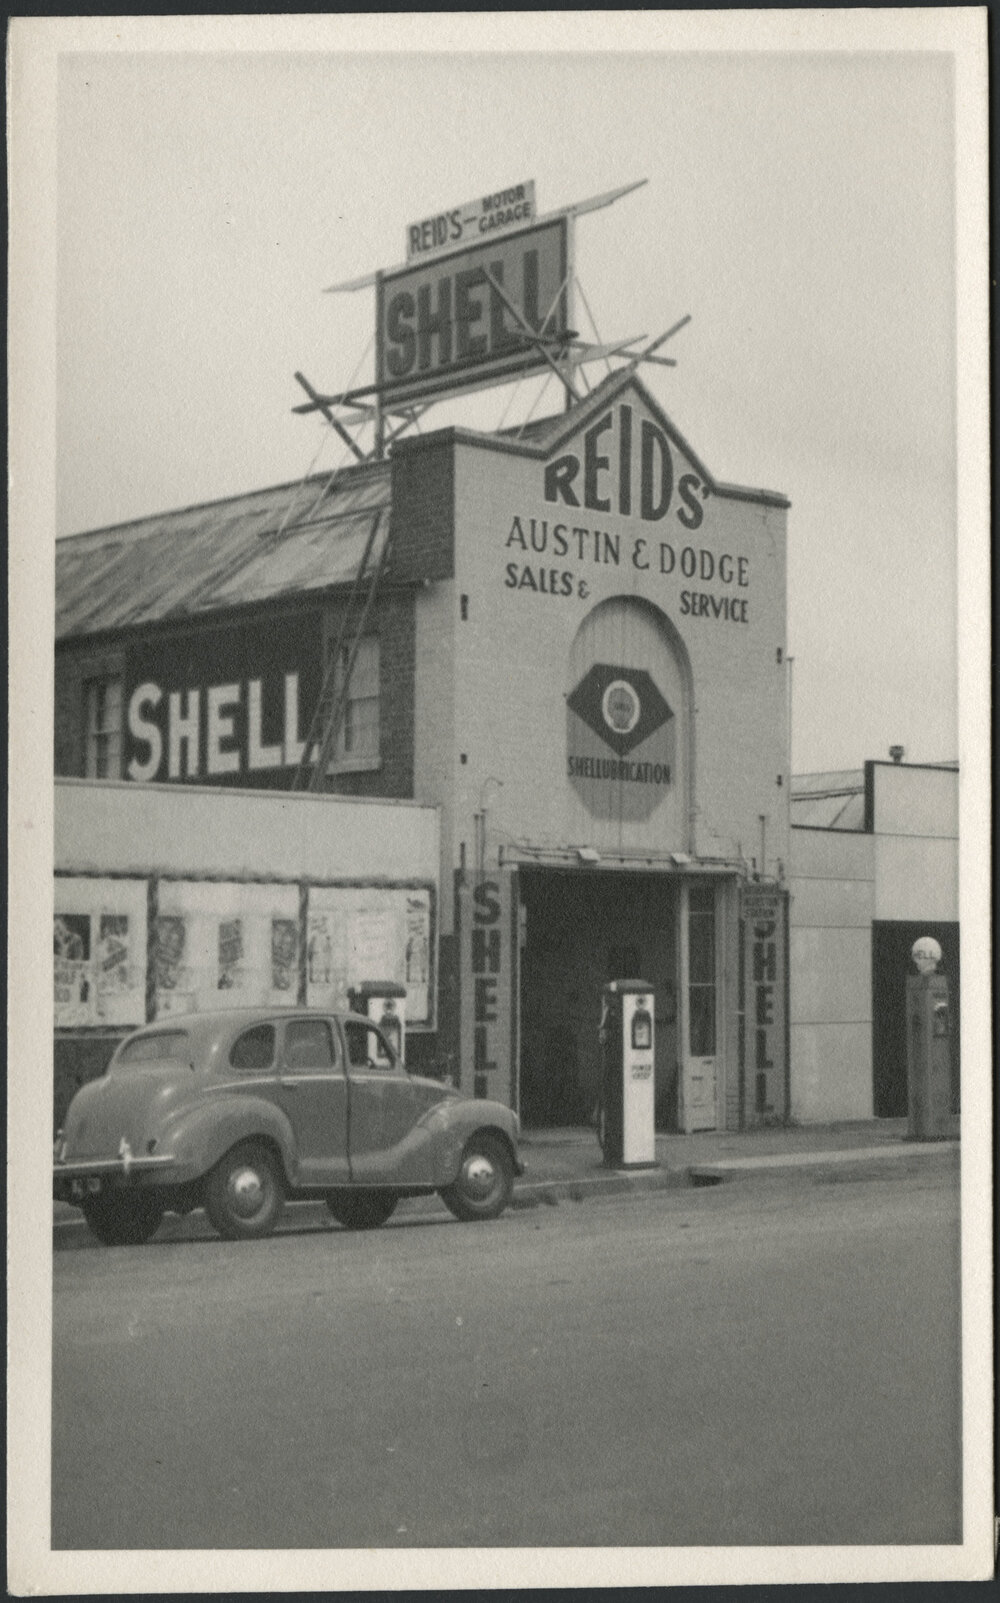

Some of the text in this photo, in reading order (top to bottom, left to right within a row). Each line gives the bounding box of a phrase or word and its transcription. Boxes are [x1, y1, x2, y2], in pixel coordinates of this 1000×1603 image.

[478, 201, 532, 233] GARAGE
[482, 184, 526, 210] MOTOR
[409, 208, 463, 254] REID'S
[386, 249, 557, 377] SHELL
[505, 515, 750, 588] AUSTIN & DODGE
[504, 562, 574, 597] SALES
[679, 590, 750, 624] SERVICE
[127, 671, 320, 781] SHELL
[568, 755, 672, 785] SHELLUBRICATION
